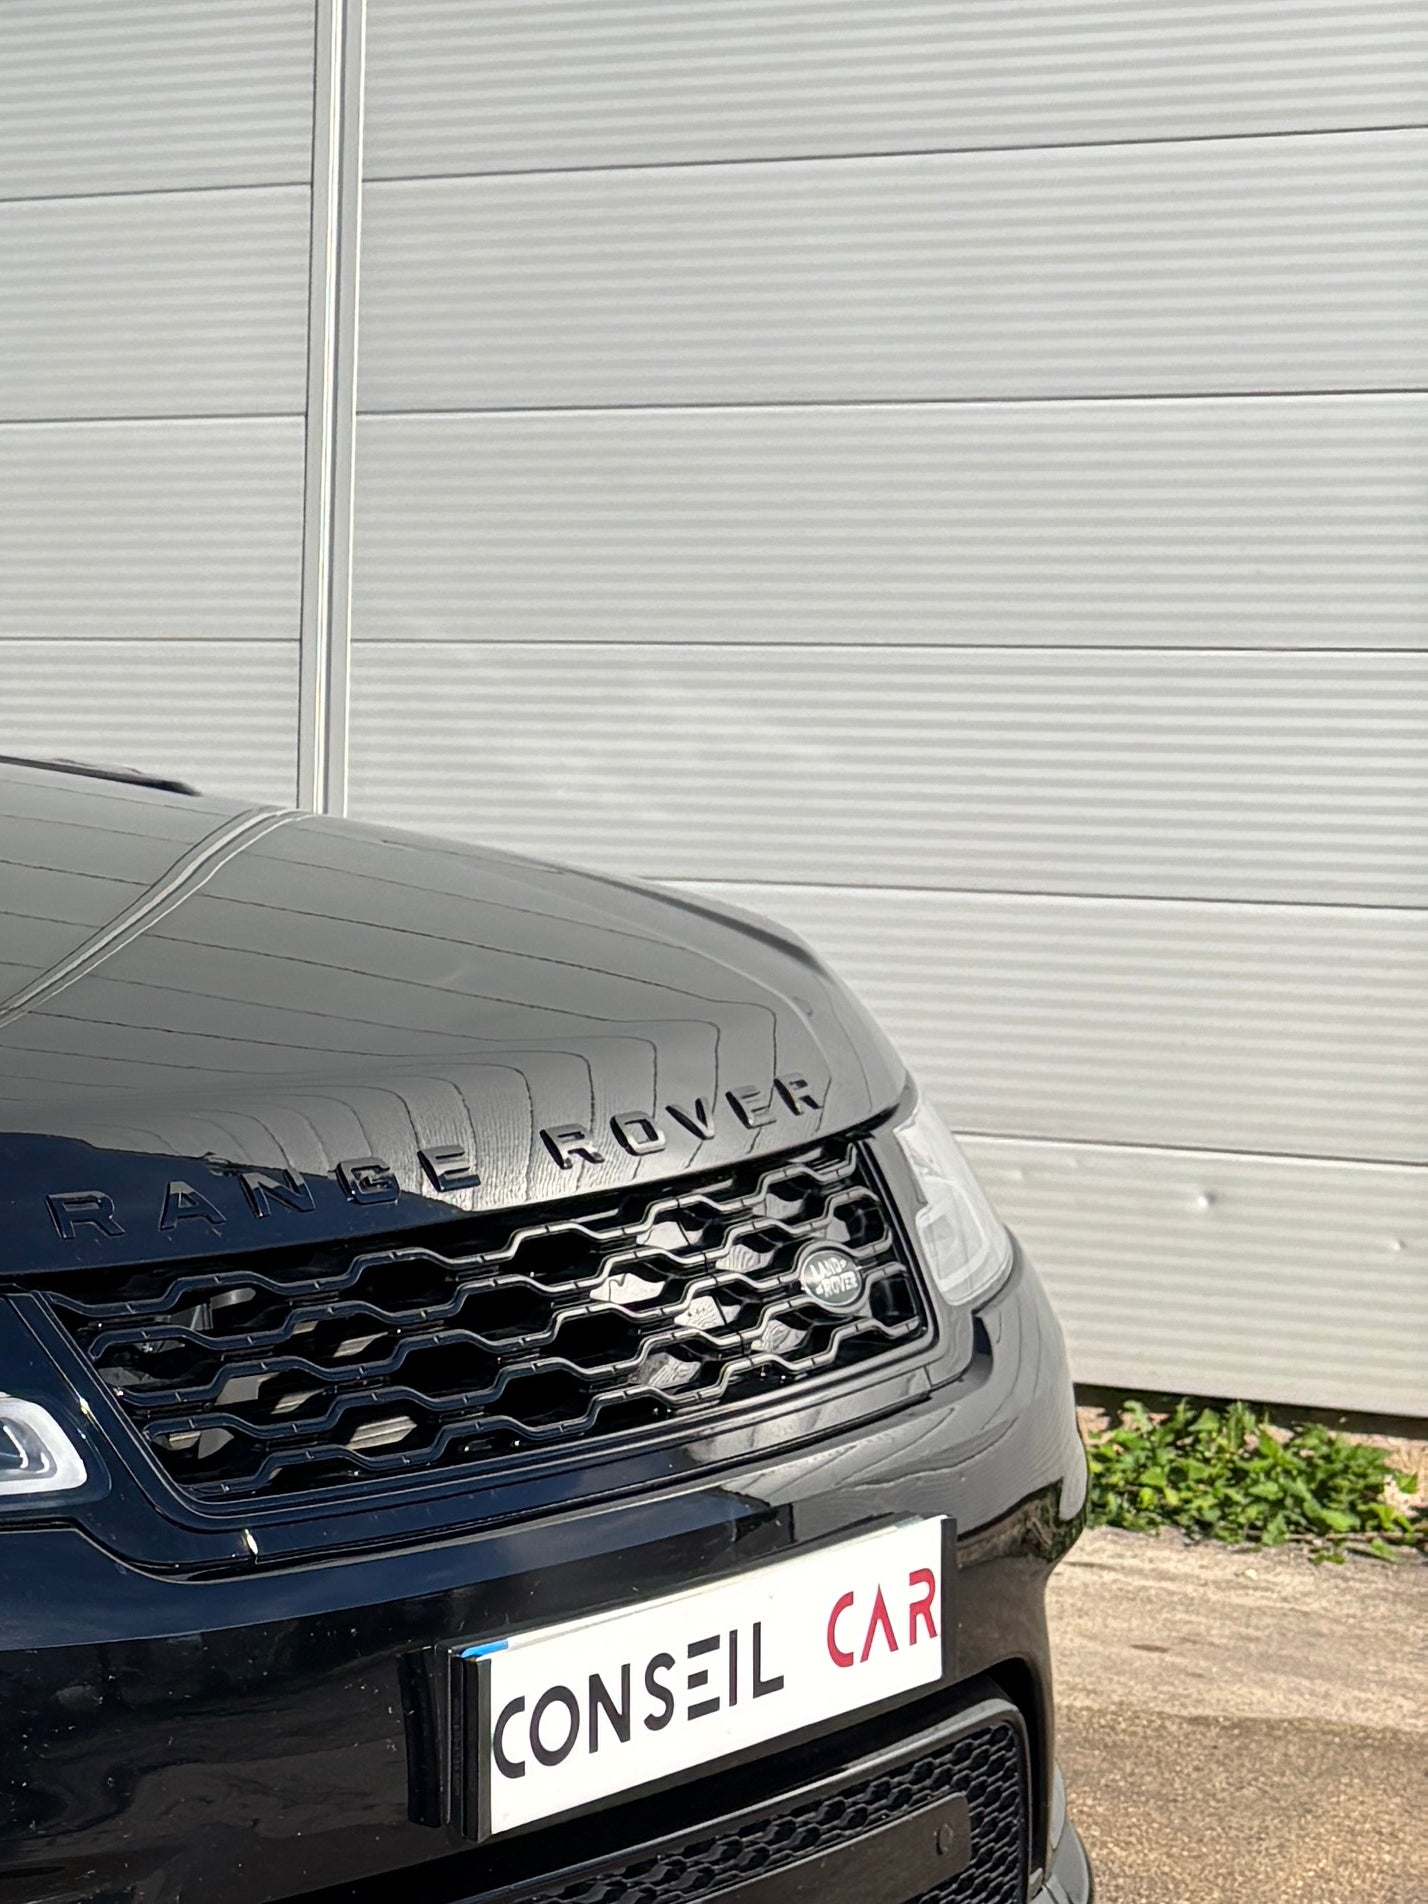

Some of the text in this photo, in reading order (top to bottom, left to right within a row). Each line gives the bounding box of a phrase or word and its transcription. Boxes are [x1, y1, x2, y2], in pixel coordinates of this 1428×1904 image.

[44, 1070, 831, 1242] RANGE ROVER
[493, 1568, 938, 1779] CONSEIL CAR
